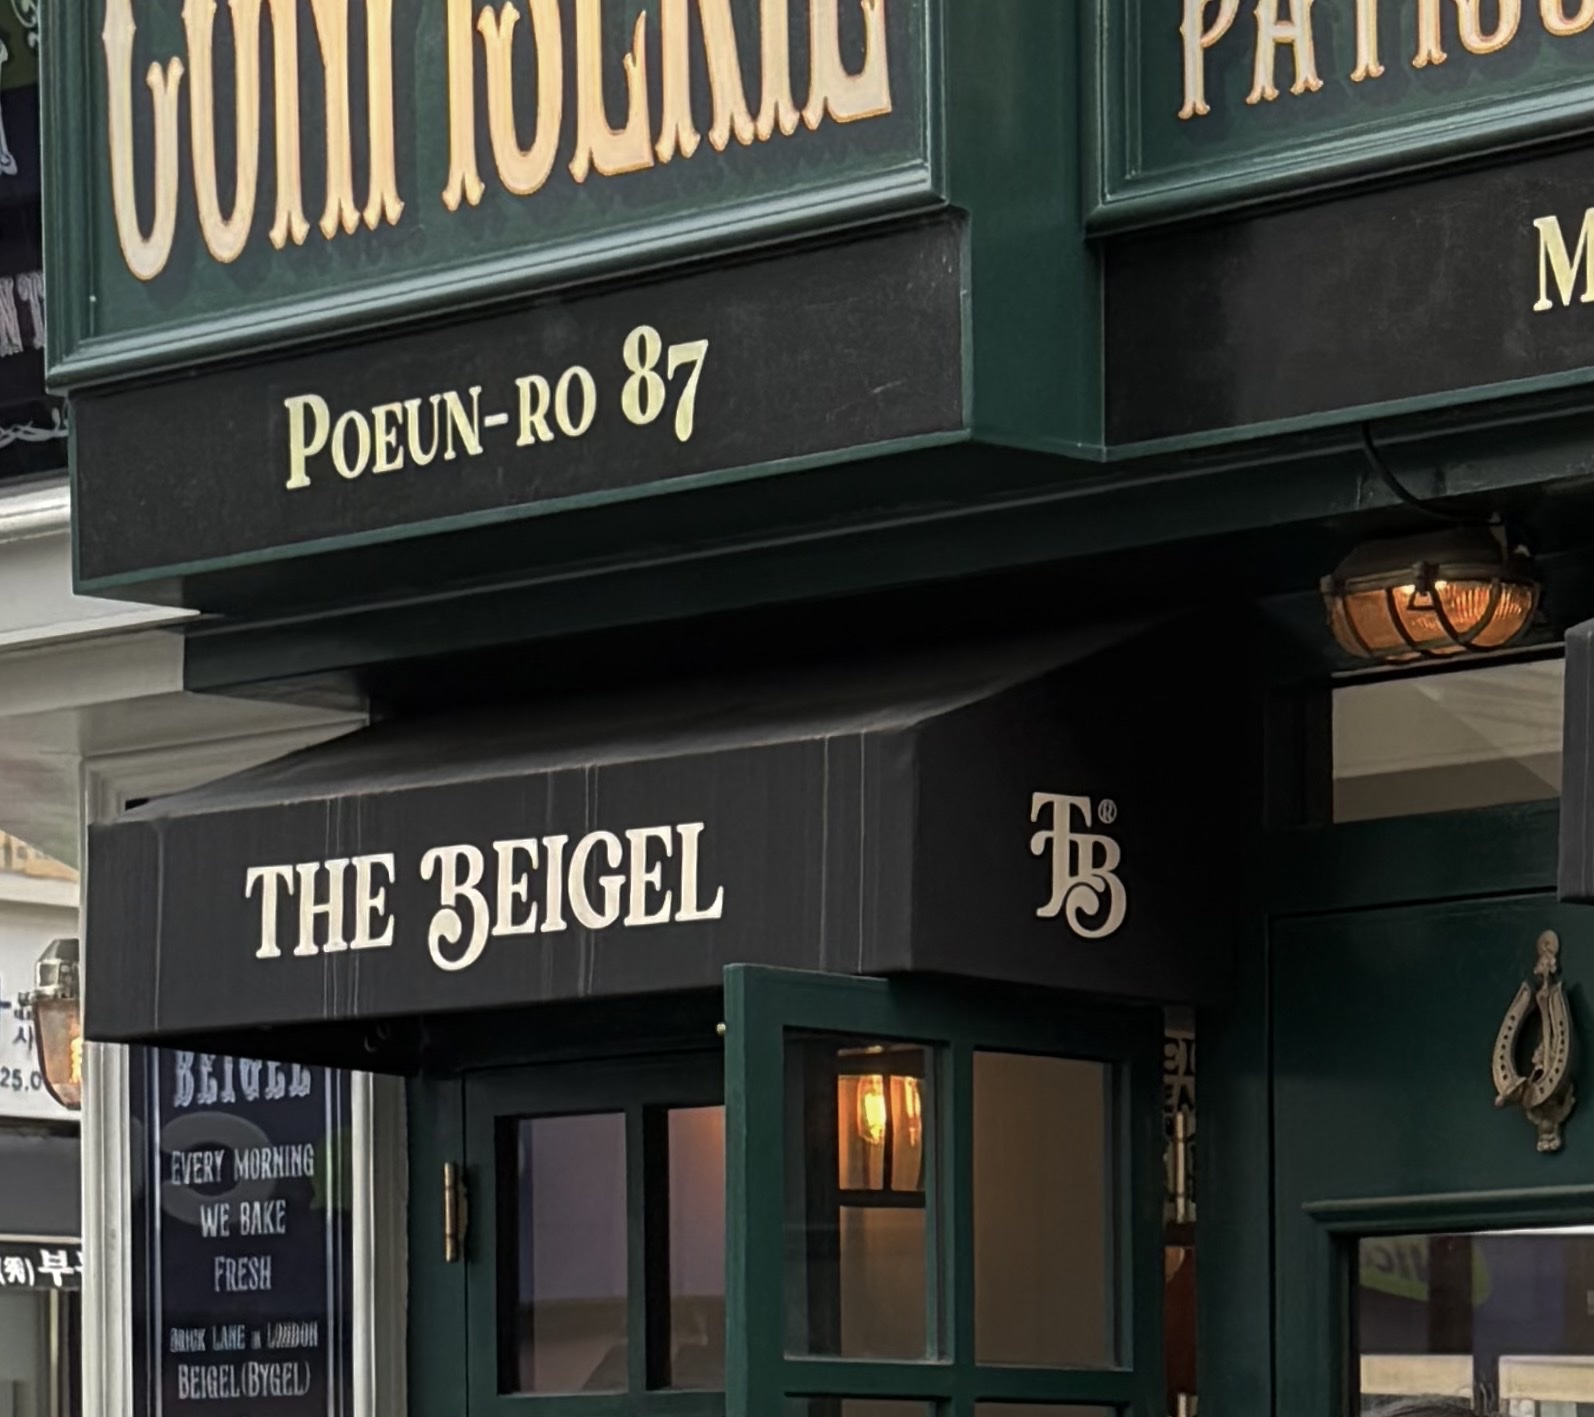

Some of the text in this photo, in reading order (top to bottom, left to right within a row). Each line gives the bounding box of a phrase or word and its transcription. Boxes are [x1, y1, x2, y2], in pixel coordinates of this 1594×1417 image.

[283, 325, 709, 490] POEUN-RO 87
[245, 822, 724, 971] THE BEIGEL
[170, 1143, 314, 1186] EVERY MORNING
[200, 1199, 286, 1237] WE BAKE
[214, 1255, 272, 1292] FRESH
[212, 1324, 245, 1351] LANE
[267, 1322, 319, 1349] LONDON
